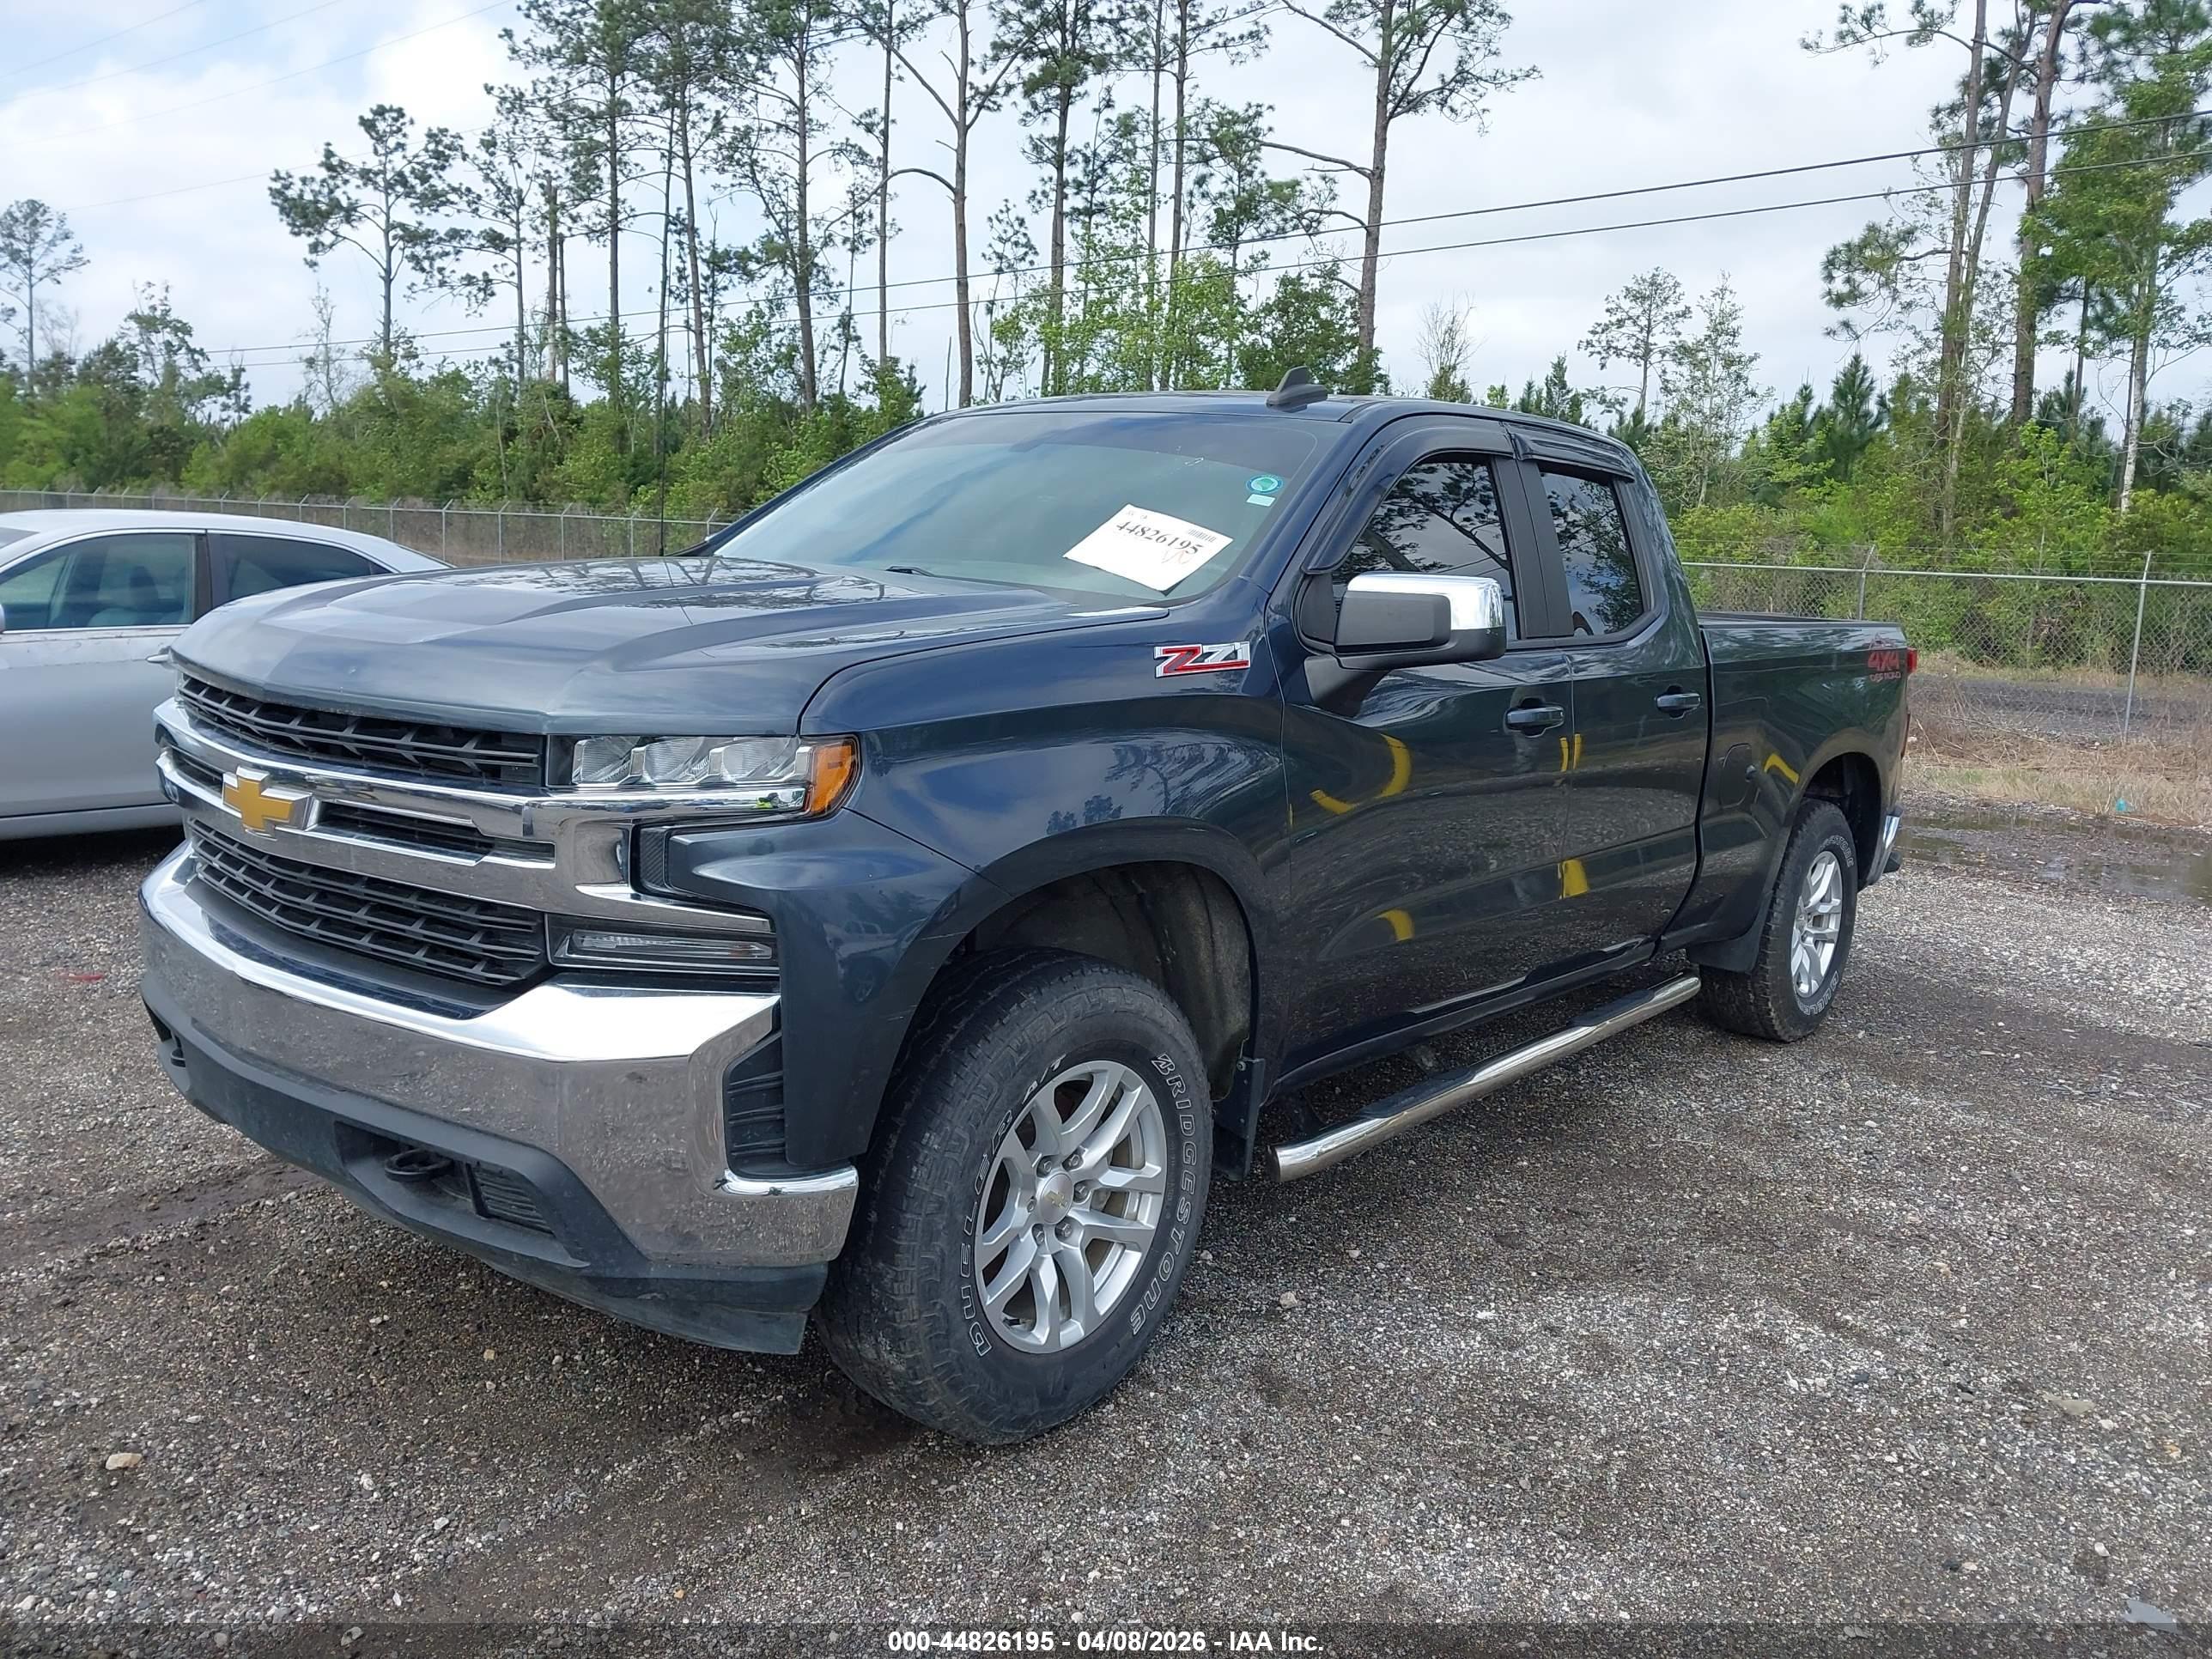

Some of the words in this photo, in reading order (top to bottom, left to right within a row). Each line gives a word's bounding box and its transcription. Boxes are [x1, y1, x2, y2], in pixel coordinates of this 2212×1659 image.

[1116, 520, 1204, 555] 44826195
[1154, 641, 1251, 678] Z71
[960, 1109, 1013, 1358] DUELER
[1129, 1053, 1197, 1335] BRIDGESTONE
